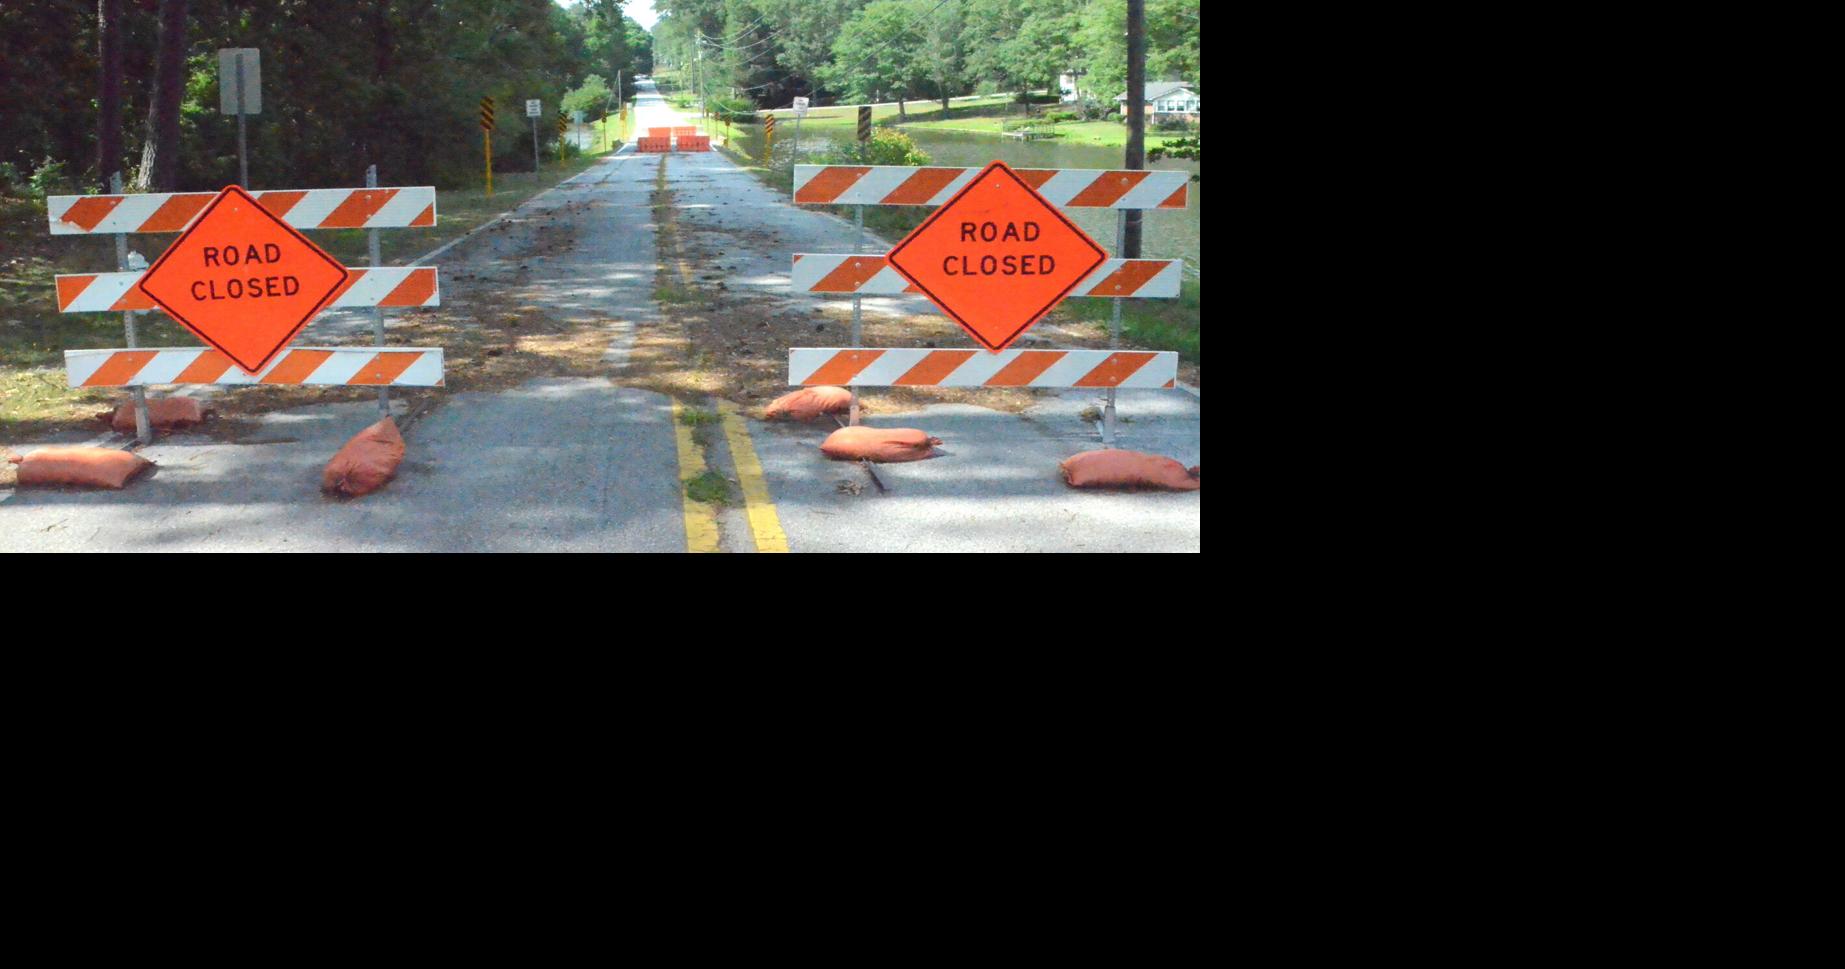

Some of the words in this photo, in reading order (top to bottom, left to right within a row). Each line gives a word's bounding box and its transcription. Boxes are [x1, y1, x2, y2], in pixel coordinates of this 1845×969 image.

[960, 221, 1040, 243] ROAD
[203, 243, 281, 267] ROAD
[943, 254, 1056, 276] CLOSED
[191, 275, 300, 301] CLOSED
